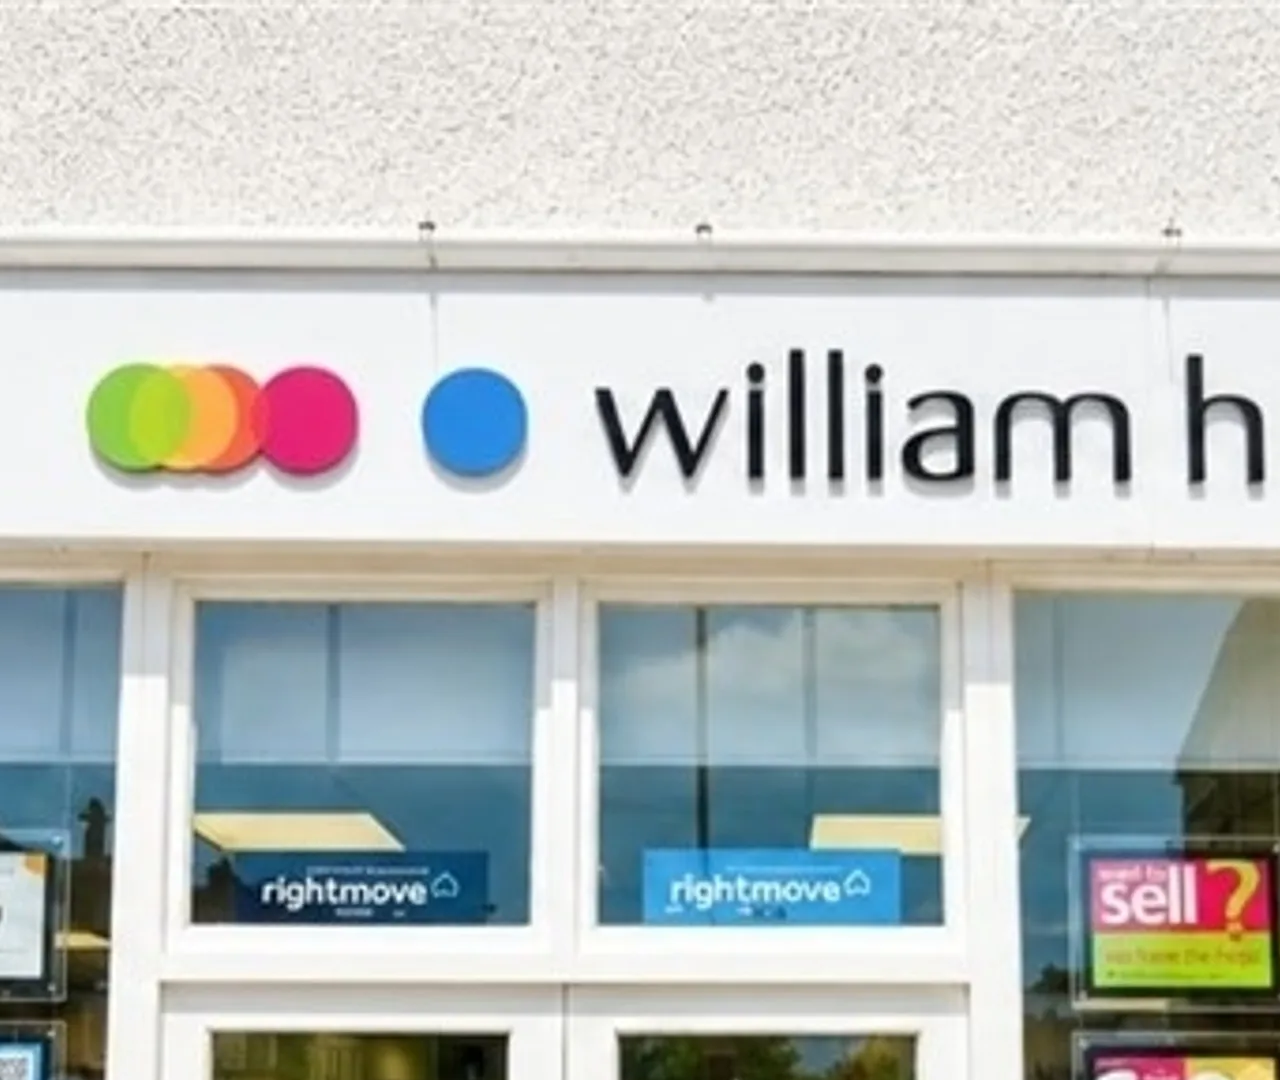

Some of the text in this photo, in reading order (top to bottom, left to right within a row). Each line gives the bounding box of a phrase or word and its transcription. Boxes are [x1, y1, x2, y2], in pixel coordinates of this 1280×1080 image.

[594, 349, 1131, 484] william
[1186, 355, 1265, 485] h
[261, 874, 428, 913] rightmove
[671, 872, 841, 912] rightmove
